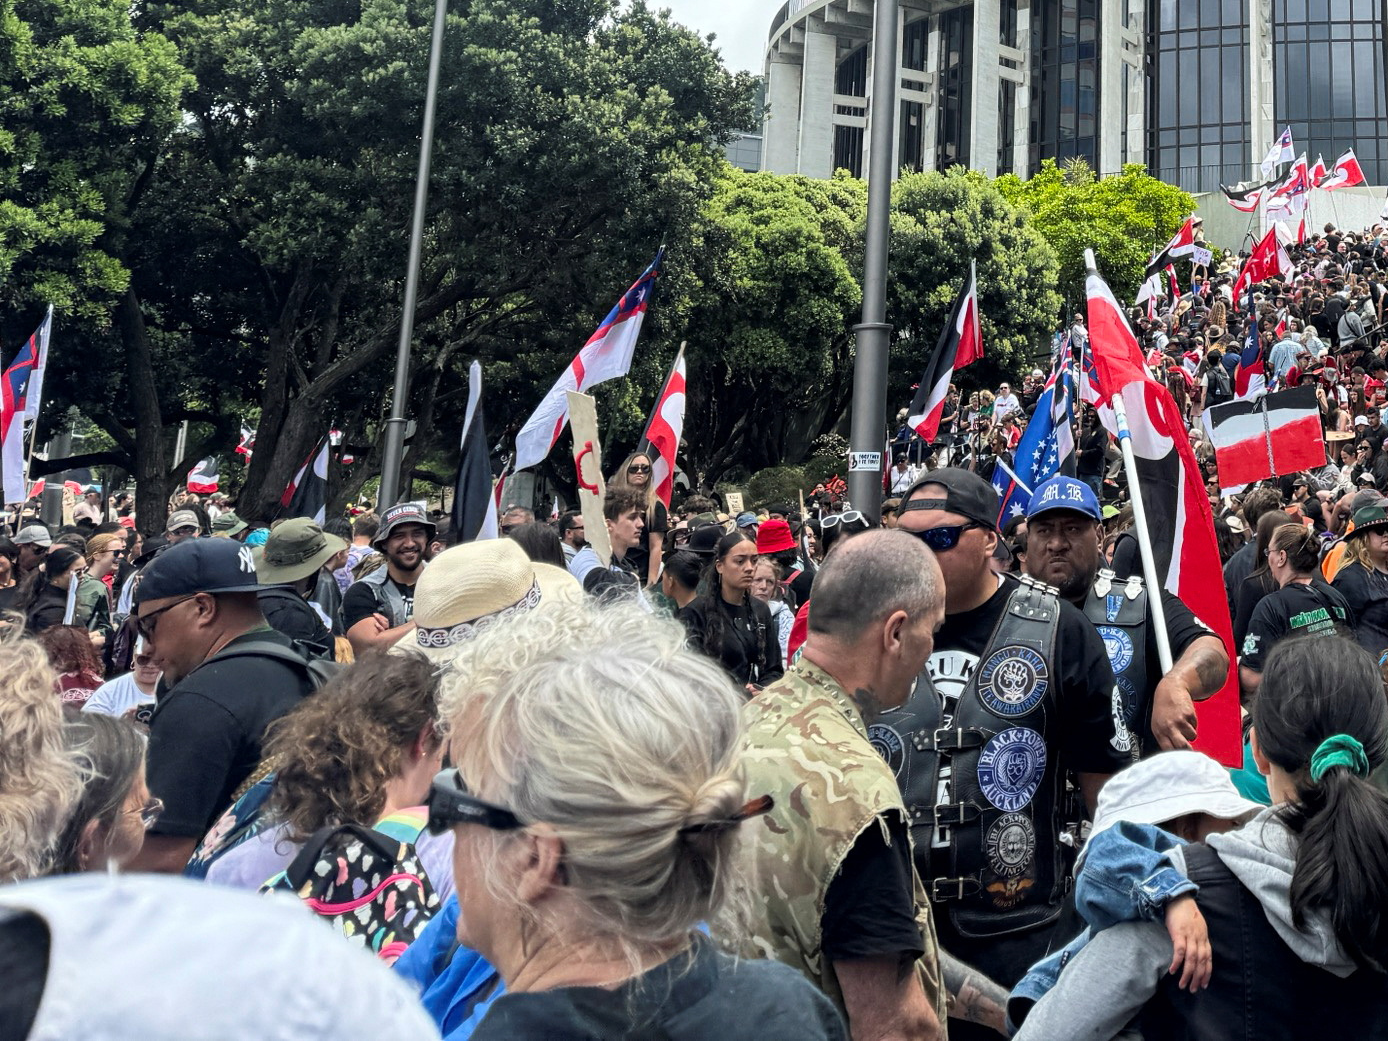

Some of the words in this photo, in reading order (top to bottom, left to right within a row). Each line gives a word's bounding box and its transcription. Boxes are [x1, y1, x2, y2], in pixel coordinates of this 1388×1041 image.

[1018, 649, 1044, 672] KAHA
[980, 729, 1020, 765] BLACK
[1021, 729, 1047, 765] POWER
[982, 781, 1037, 810] AUCKLAND
[989, 815, 1015, 841] BLACK
